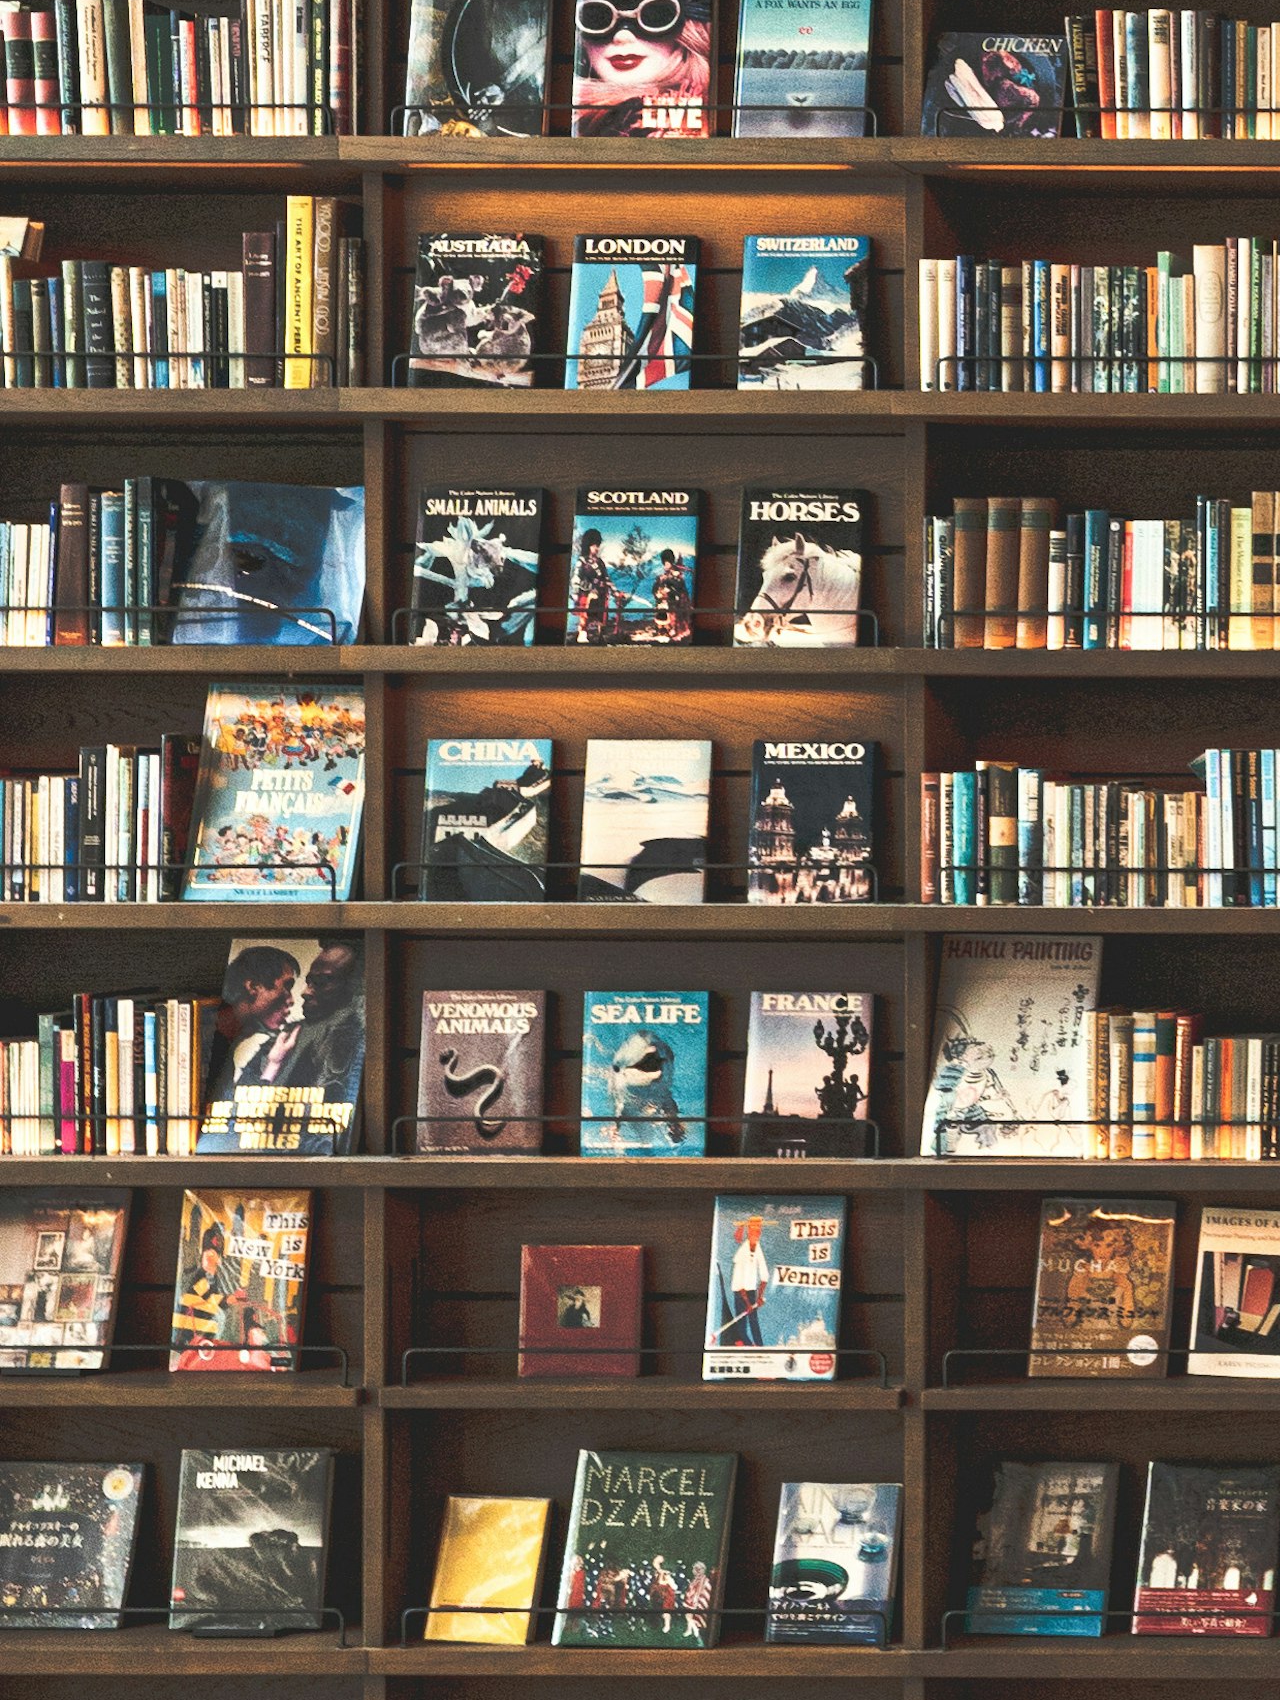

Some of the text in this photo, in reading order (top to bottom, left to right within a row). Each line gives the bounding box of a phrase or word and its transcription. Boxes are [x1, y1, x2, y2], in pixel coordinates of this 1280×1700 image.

[981, 36, 1063, 54] CHICKEN
[641, 107, 703, 129] LIVE
[584, 239, 686, 254] LONDON
[756, 237, 859, 252] SWITZERLAND
[586, 491, 690, 505] SCOTLAND
[424, 499, 537, 516] SMALL ANIMALS
[749, 501, 860, 523] HORSES
[439, 741, 544, 763] CHINA
[764, 742, 866, 760] MEXICO
[429, 1002, 538, 1018] VENOMOUS
[761, 992, 864, 1010] FRANCE
[590, 1004, 702, 1024] SEA LIFE
[435, 1019, 530, 1035] ANIMALS
[267, 1214, 309, 1231] This
[794, 1221, 836, 1238] This
[230, 1238, 270, 1258] New
[284, 1237, 303, 1252] is
[812, 1247, 828, 1261] is
[261, 1260, 306, 1279] York
[777, 1267, 841, 1288] Venice
[212, 1454, 269, 1472] MICHAEL
[196, 1471, 239, 1489] KENNA
[586, 1465, 715, 1496] MARCEL
[580, 1498, 711, 1530] DZAMA
